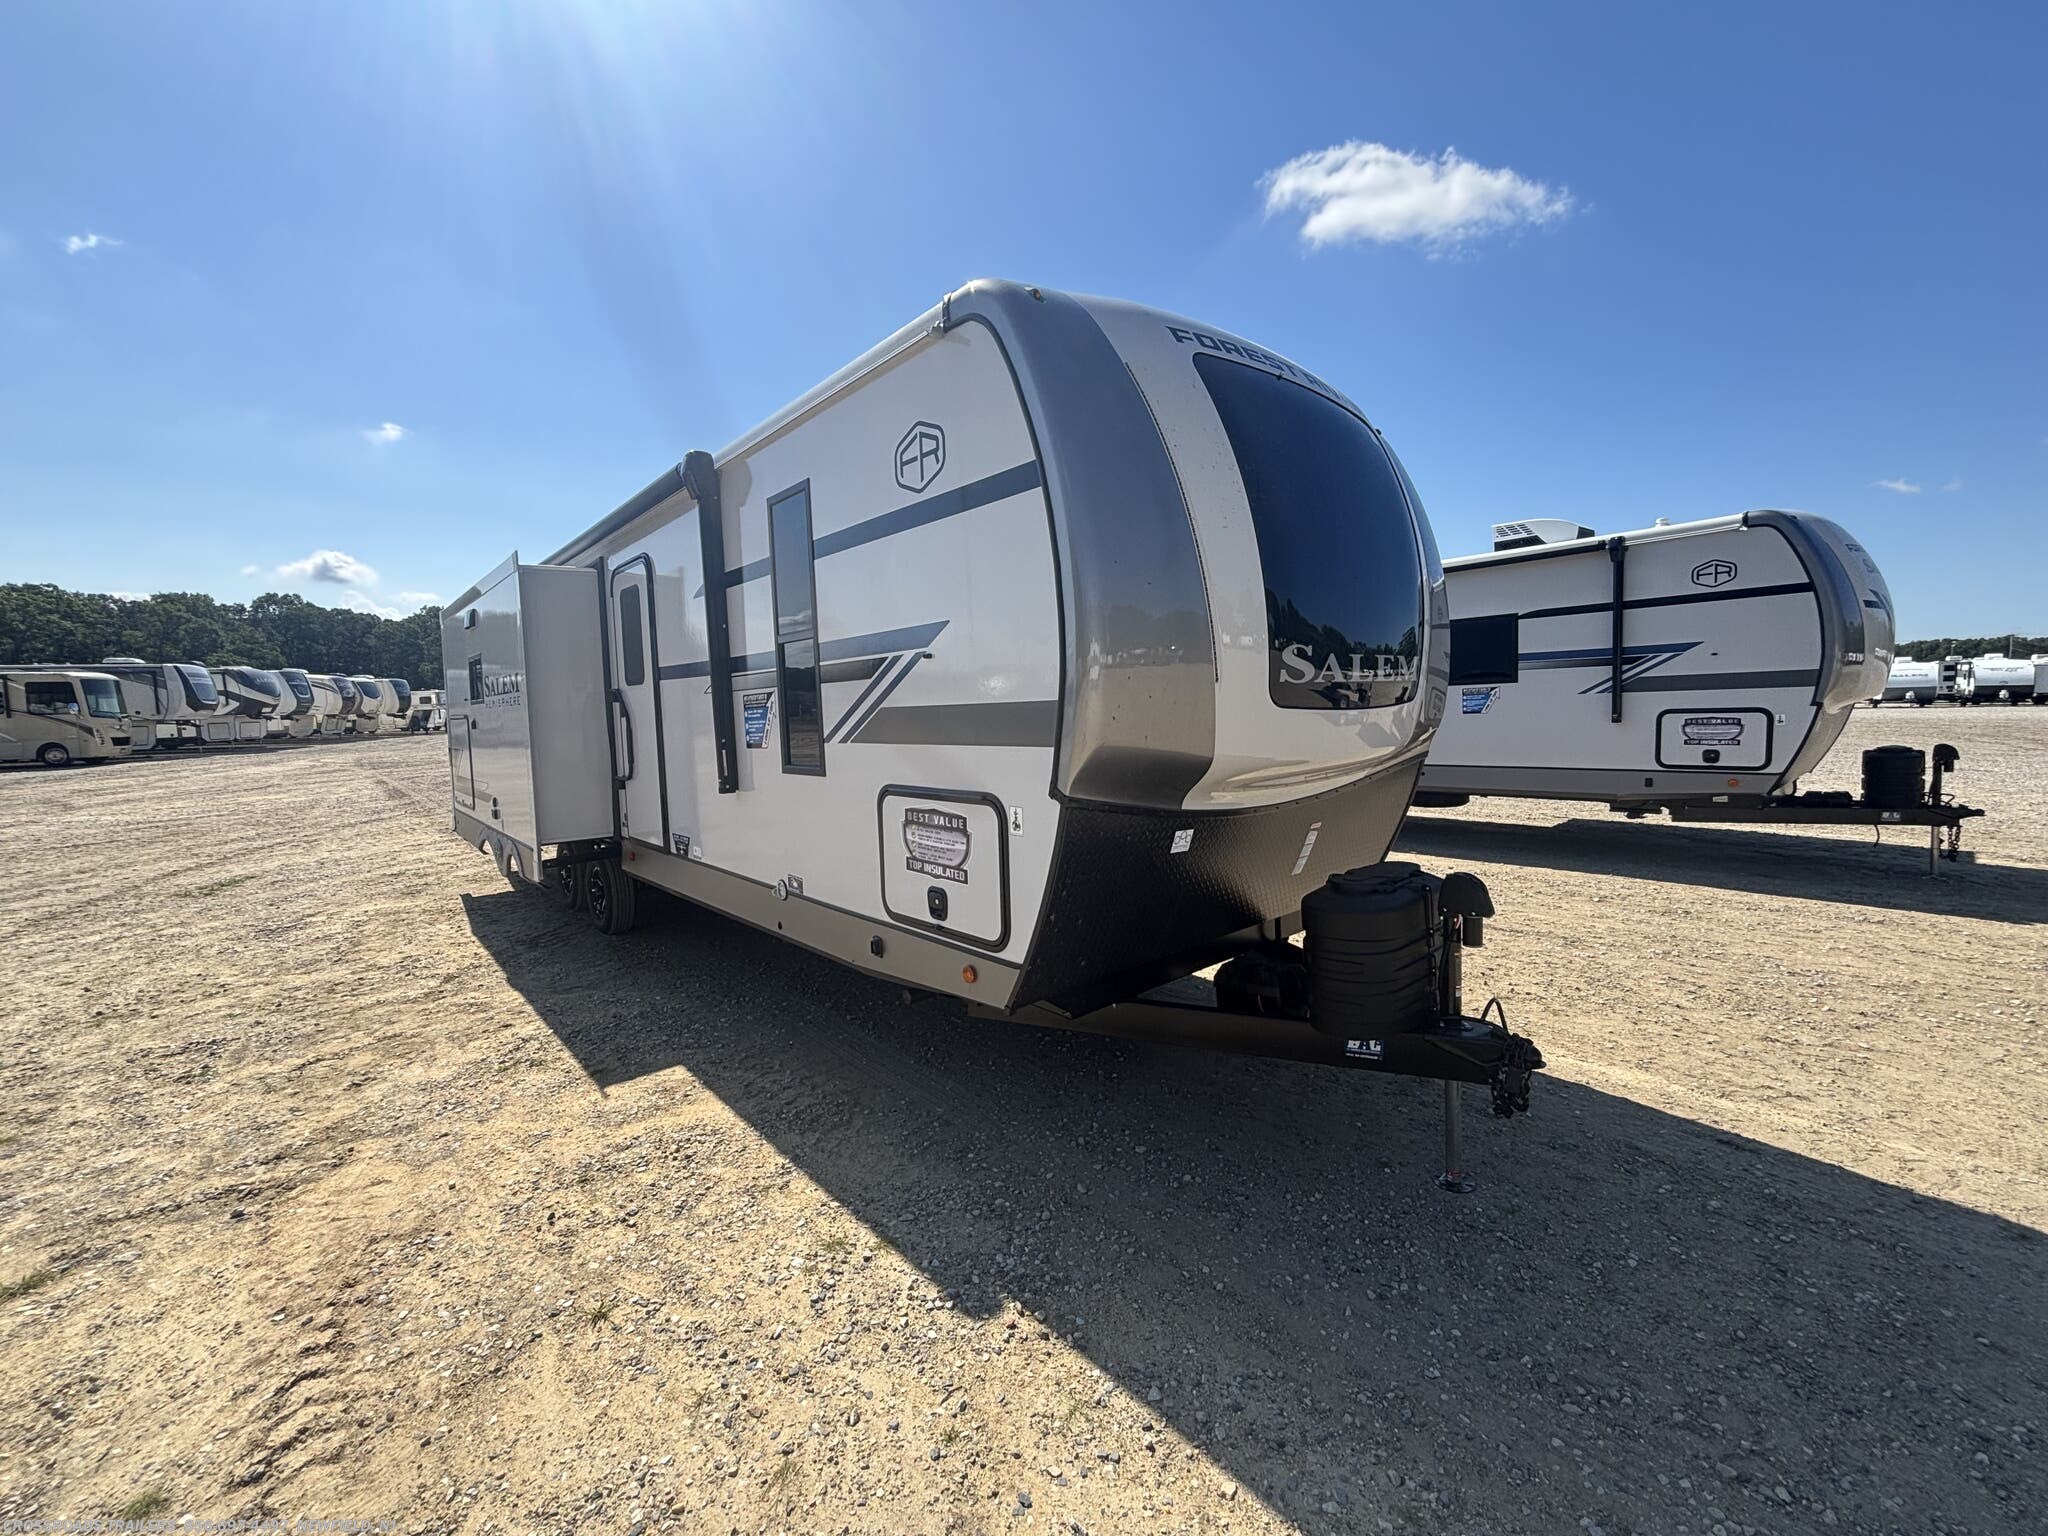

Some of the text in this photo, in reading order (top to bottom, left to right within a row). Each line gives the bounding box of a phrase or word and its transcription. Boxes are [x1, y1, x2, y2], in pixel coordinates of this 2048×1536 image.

[1164, 325, 1298, 378] FOREST
[1279, 643, 1420, 685] SALEM
[484, 672, 520, 698] SALEM
[907, 812, 965, 829] BEST VALUE
[908, 858, 965, 881] TOP INSULATED
